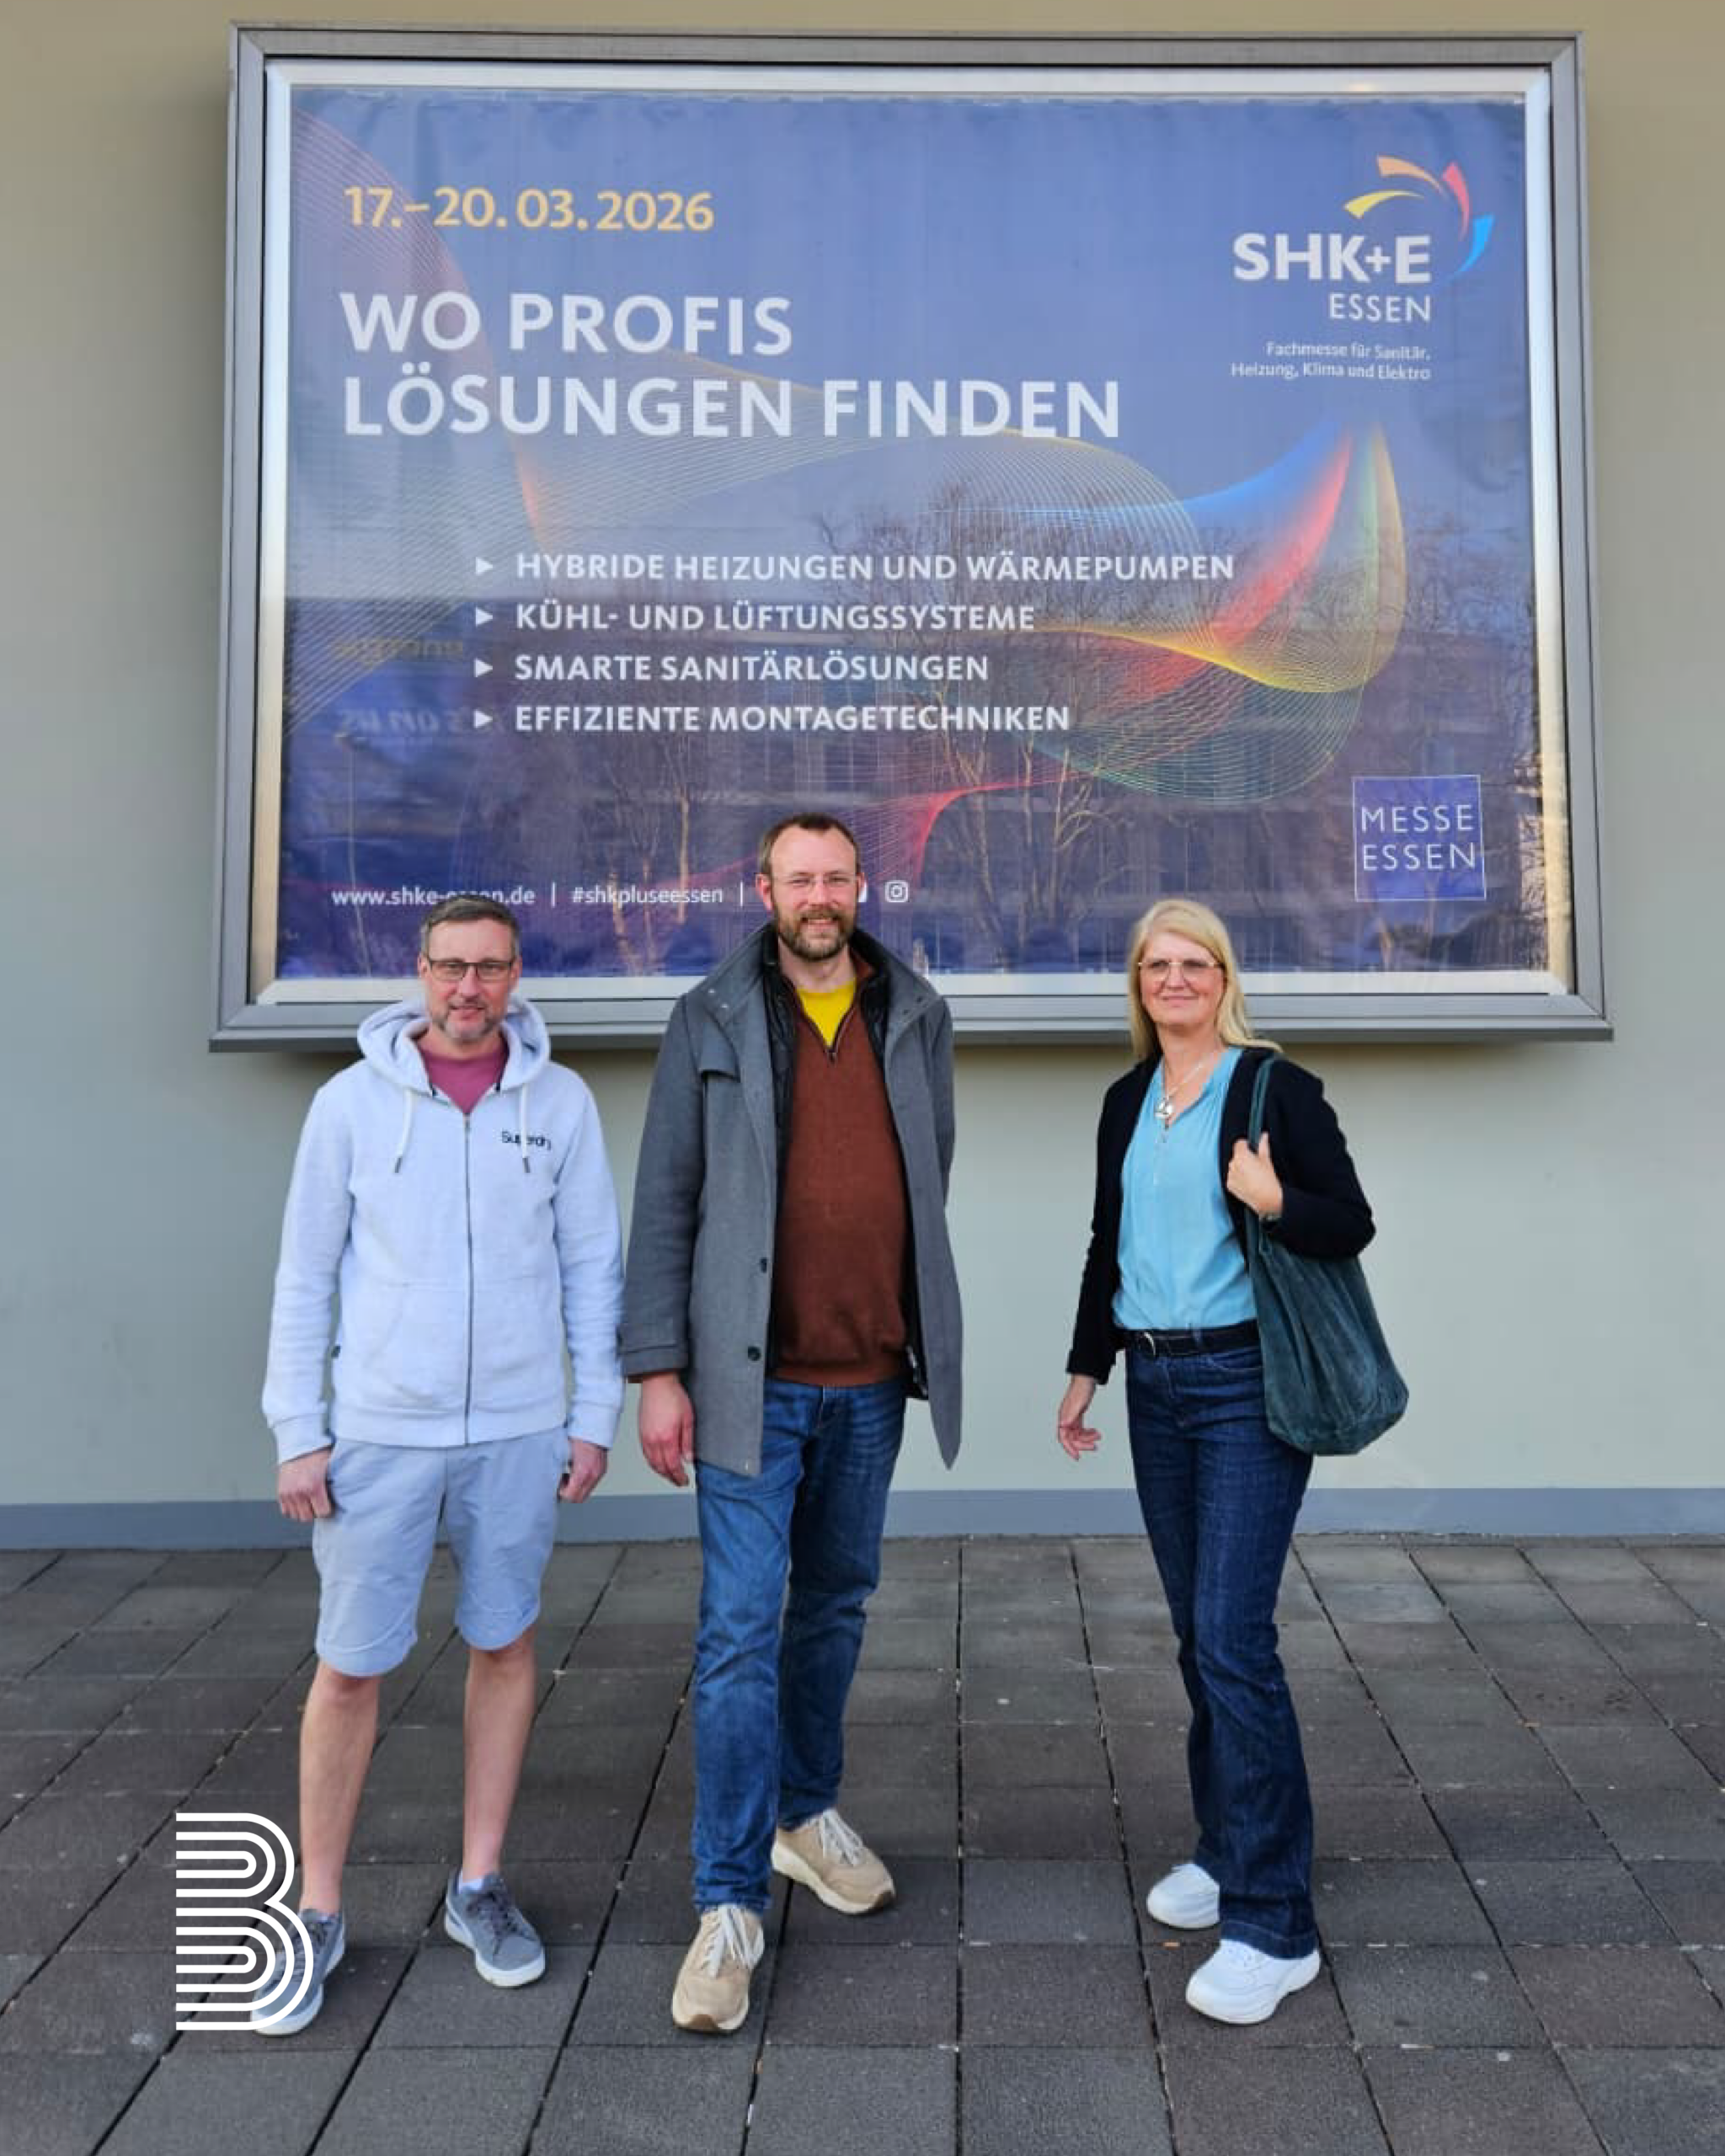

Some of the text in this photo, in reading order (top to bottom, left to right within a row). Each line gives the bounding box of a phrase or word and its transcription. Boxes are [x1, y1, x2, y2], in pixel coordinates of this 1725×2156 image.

[1232, 232, 1431, 284] SHK+E
[1329, 292, 1431, 323] ESSEN
[339, 290, 793, 356] WO PROFIS
[1266, 340, 1431, 362] Fachmesse für Sanitär,
[1231, 362, 1431, 381] Heizung, Klima und Elektro
[344, 360, 1119, 438] LÖSUNGEN FINDEN
[515, 552, 1234, 580] HYBRIDE HEIZUNGEN UND WÄRMEPUMPEN
[515, 598, 1034, 631] KÜHL- UND LÜFTUNGSSYSTEME
[515, 651, 989, 680] SMARTE SANITÄRLÖSUNGEN
[515, 706, 1070, 732] EFFIZIENTE MONTAGETECHNIKEN
[1360, 804, 1474, 833] MESSE
[1363, 842, 1475, 871] ESSEN
[331, 883, 723, 909] www.shke-n.de #shkpluseessen
